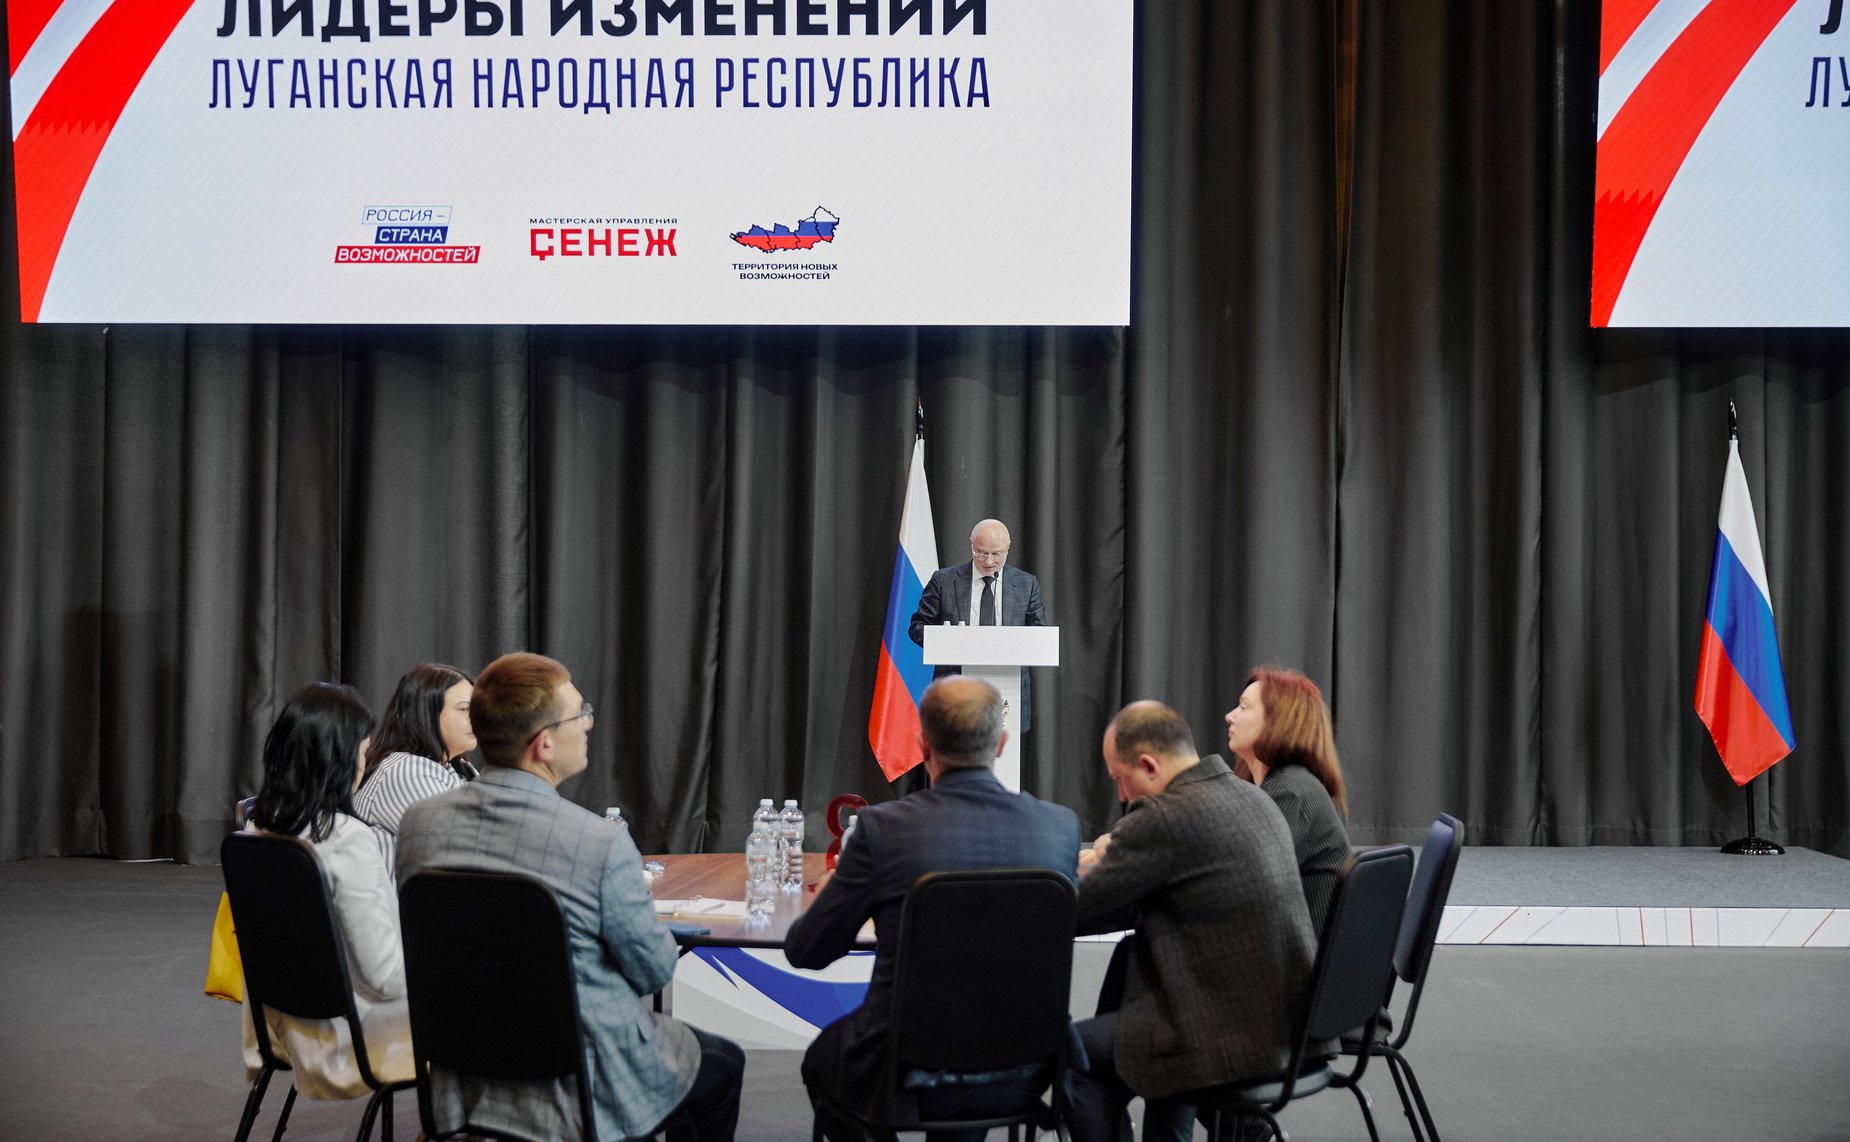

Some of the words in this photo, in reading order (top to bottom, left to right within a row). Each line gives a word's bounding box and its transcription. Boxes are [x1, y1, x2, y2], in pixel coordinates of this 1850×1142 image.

[216, 0, 524, 43] ЛИДЕРЫ
[208, 58, 453, 109] ЛУГАНСКАЯ
[472, 57, 695, 115] НАРОДНАЯ
[715, 57, 990, 109] РЕСПУБЛИКА
[365, 208, 433, 222] РОССИЯ
[378, 228, 443, 242] СТРАНА
[337, 246, 476, 262] ВОЗМОЖНОСТЕЙ
[731, 263, 799, 271] ТЕРРИТОРИЯ
[800, 263, 838, 271] НОВЫХ
[739, 271, 830, 280] ВОЗМОЖНОСТЕЙ
